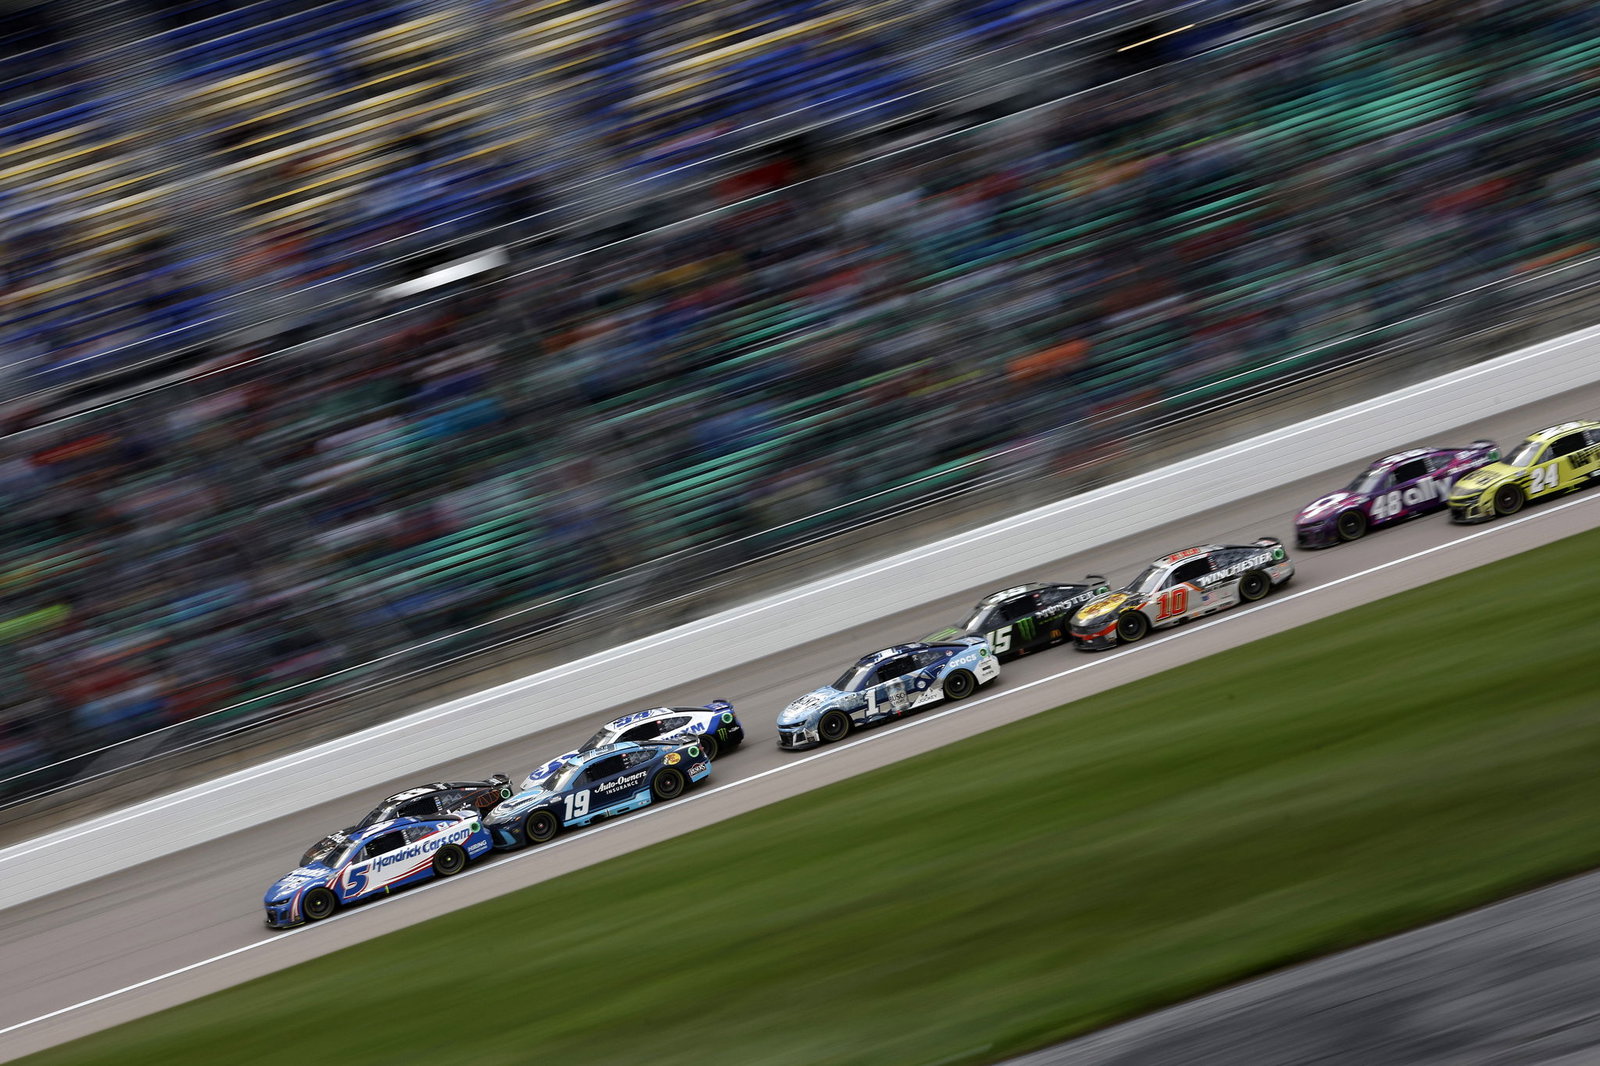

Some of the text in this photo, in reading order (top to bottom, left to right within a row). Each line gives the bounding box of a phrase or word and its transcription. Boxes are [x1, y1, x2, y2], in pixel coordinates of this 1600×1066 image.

[1530, 463, 1559, 494] 24
[1371, 476, 1452, 519] 48 ally
[1196, 552, 1273, 586] WINCHESTER
[1156, 588, 1188, 622] 10
[949, 653, 977, 668] crocs
[864, 688, 879, 716] 1
[594, 770, 647, 794] Auto-Owners
[606, 780, 638, 795] INSURANCE
[564, 789, 590, 821] 19
[372, 845, 421, 872] Hendrick
[422, 828, 470, 853] Cars.com
[344, 864, 371, 900] 5
